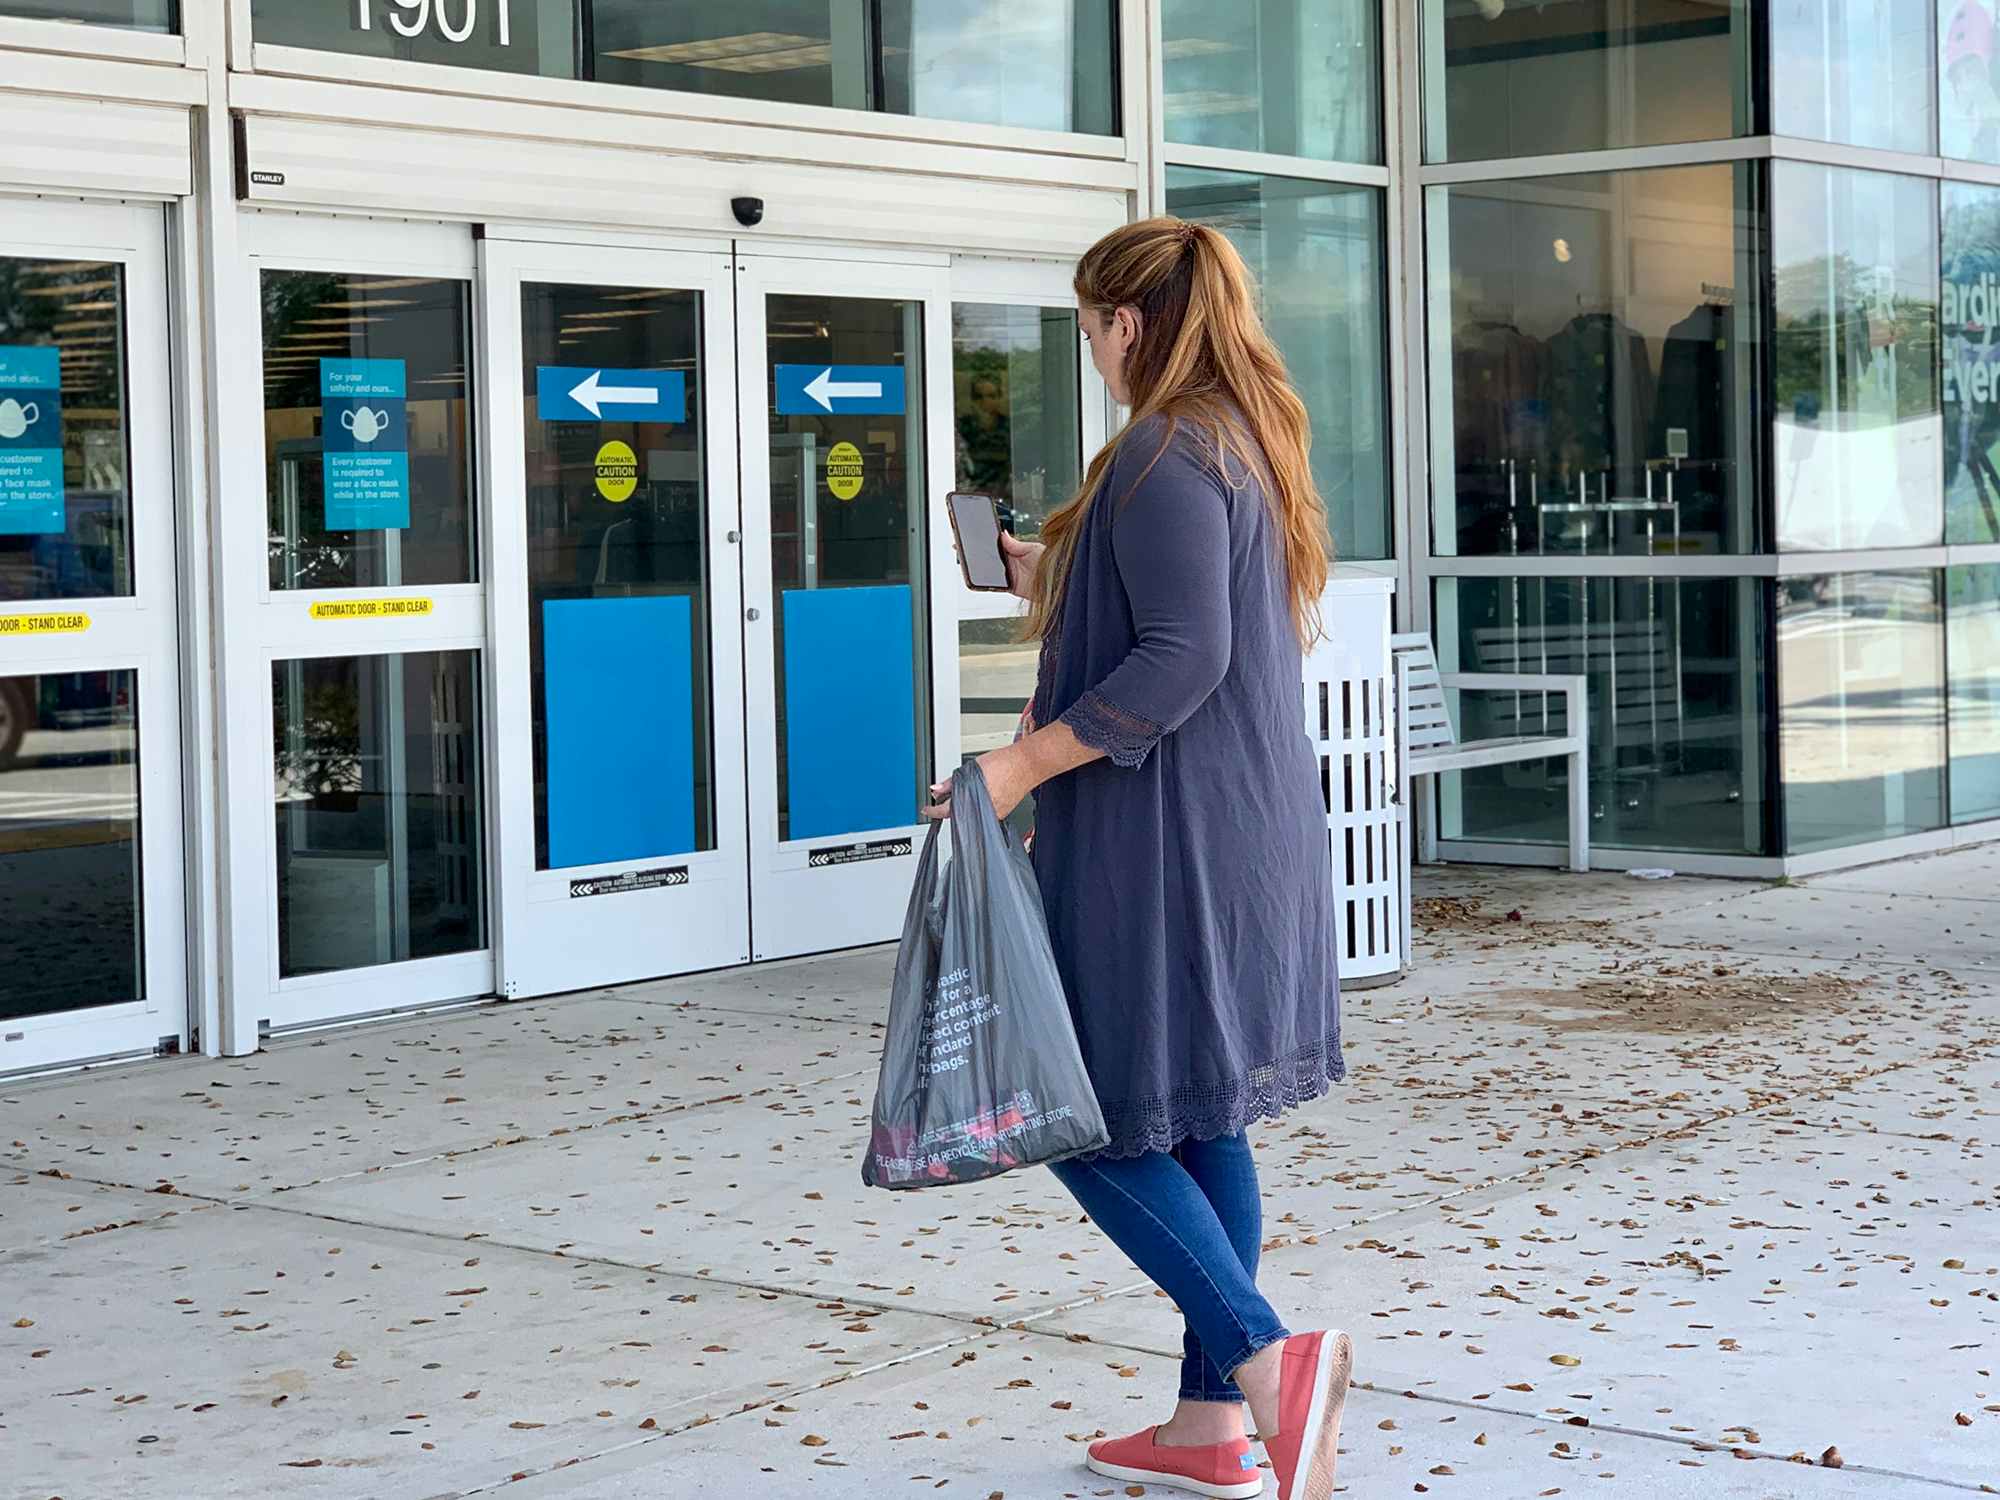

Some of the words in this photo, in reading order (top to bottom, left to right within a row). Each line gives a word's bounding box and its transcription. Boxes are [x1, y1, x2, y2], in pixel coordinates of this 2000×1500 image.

[360, 0, 510, 46] 1901
[253, 173, 282, 183] STANLEY
[329, 371, 342, 381] For
[345, 374, 362, 383] your
[329, 384, 353, 393] safety
[0, 454, 43, 463] customer
[332, 457, 353, 467] Every
[355, 458, 392, 466] customer
[829, 454, 860, 462] AUTOMATIC
[23, 467, 33, 475] to
[332, 467, 339, 476] is
[341, 469, 374, 478] required
[375, 468, 384, 476] to
[597, 466, 635, 476] CAUTION
[827, 465, 862, 476] CAUTION
[5, 479, 25, 488] face
[27, 479, 52, 488] mask
[360, 479, 377, 487] face
[379, 478, 400, 487] mask
[838, 479, 853, 487] DOOR
[10, 491, 26, 499] the
[28, 491, 54, 500] store.
[333, 490, 354, 499] while
[355, 490, 363, 498] in
[365, 490, 378, 498] the
[380, 490, 400, 498] store.
[316, 603, 356, 616] AUTOMATIC
[357, 602, 377, 614] DOOR
[383, 601, 405, 613] STAND
[406, 600, 428, 611] CLEAR
[28, 617, 55, 630] STAND
[57, 616, 83, 629] CLEAR
[942, 988, 960, 1002] for
[963, 985, 972, 995] a
[935, 993, 991, 1023] rcentage
[953, 1003, 1001, 1033] content
[931, 1032, 973, 1057] ndard
[930, 1055, 969, 1074] bags.
[927, 1152, 940, 1166] OR
[941, 1142, 977, 1163] RECYCLE
[1046, 1104, 1073, 1124] STORE
